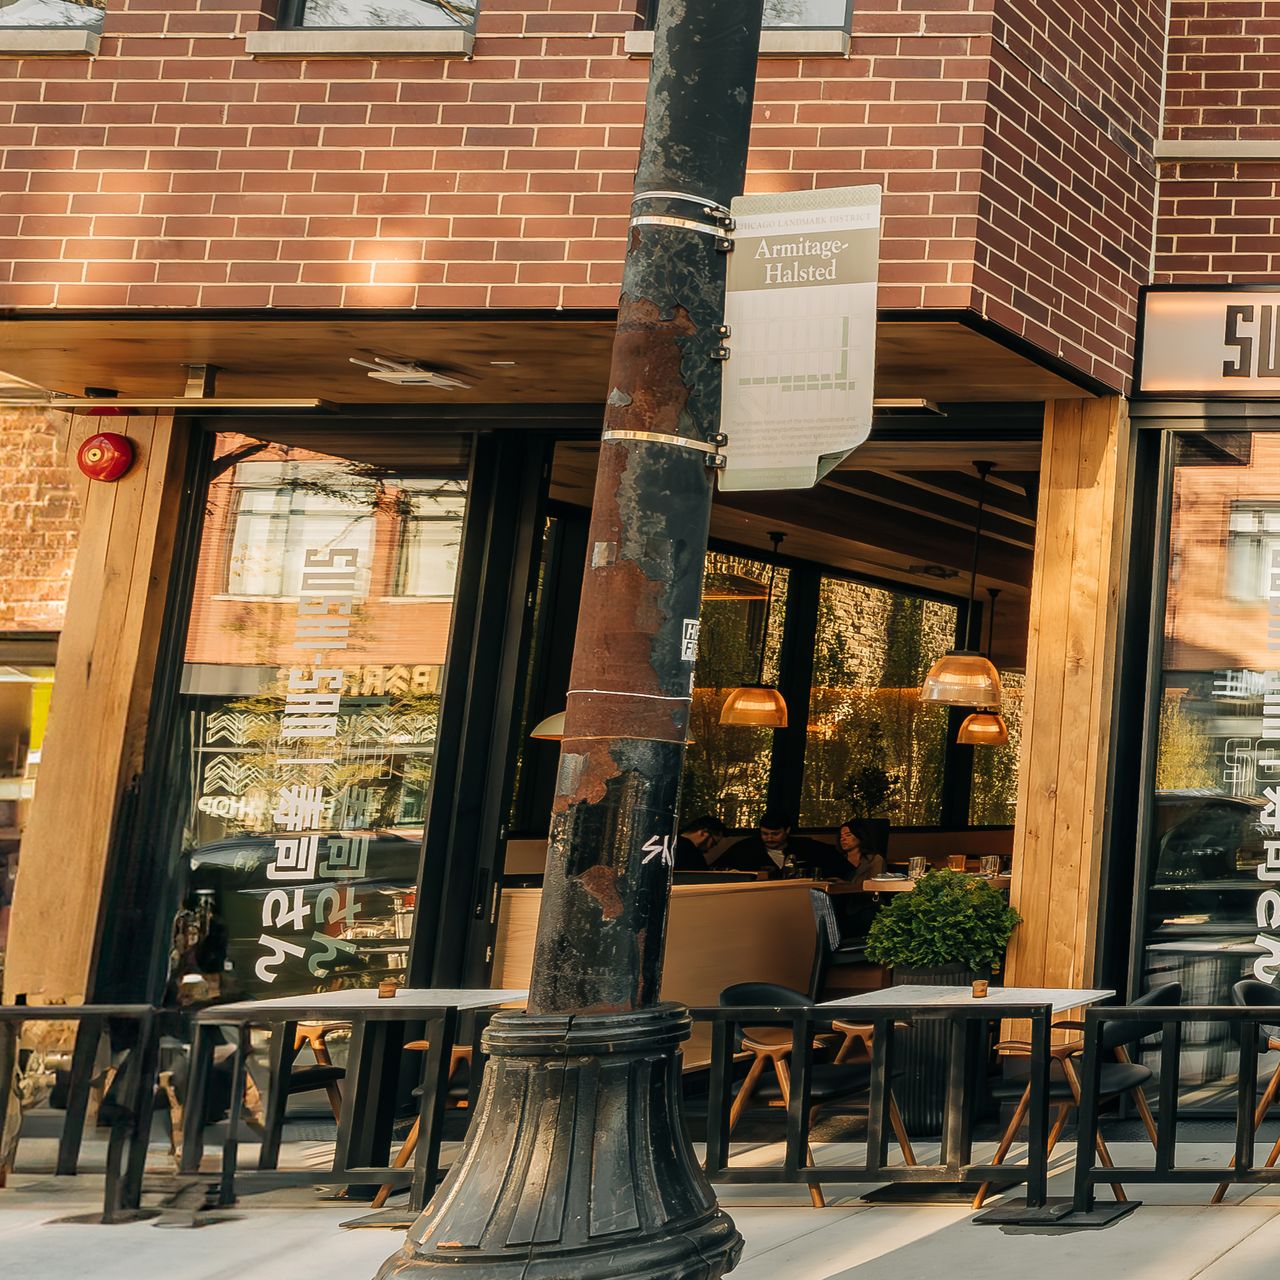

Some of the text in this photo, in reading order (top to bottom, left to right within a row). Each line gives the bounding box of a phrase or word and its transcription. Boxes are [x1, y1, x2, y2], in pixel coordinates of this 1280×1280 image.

[777, 218, 827, 229] LANDMARK
[829, 213, 872, 225] DISTRICT
[754, 237, 849, 259] Armitage-
[764, 259, 837, 284] Halsted
[281, 548, 359, 736] SUSHI-SAN
[255, 784, 324, 984] 寿司さん
